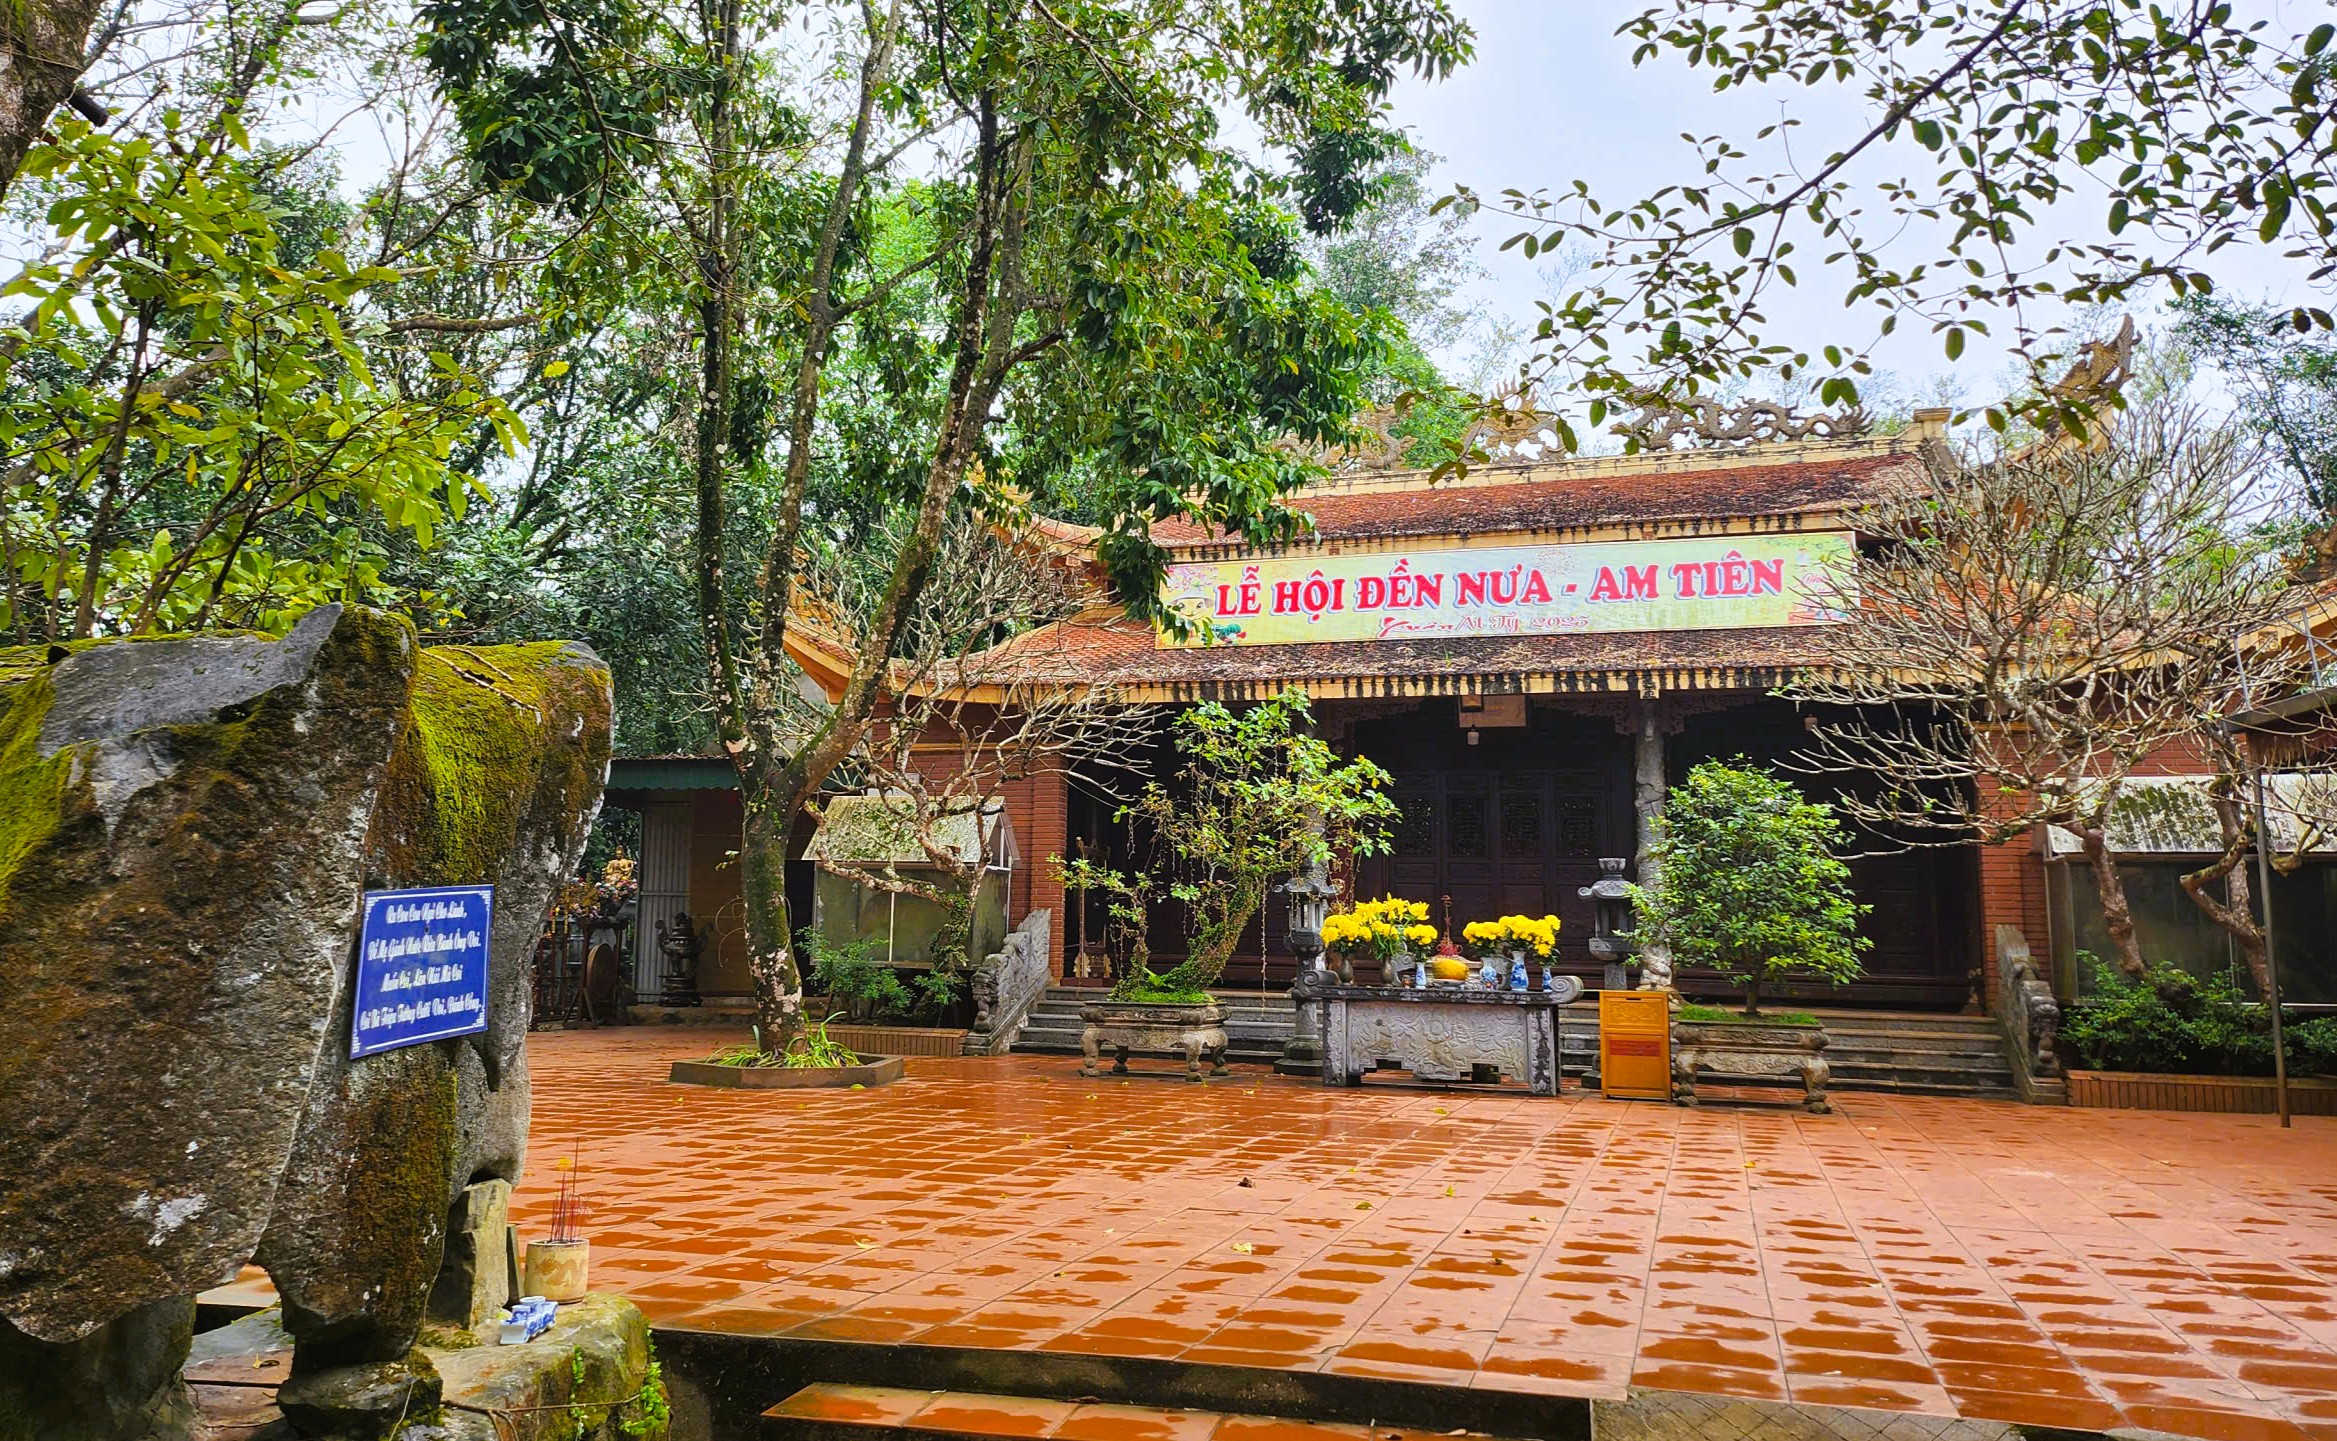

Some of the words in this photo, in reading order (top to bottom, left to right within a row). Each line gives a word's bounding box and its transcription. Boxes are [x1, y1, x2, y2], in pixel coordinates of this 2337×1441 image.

[1214, 565, 1263, 617] LỄ
[1273, 569, 1347, 622] HỘI
[1356, 557, 1445, 610] ĐỀN
[1456, 563, 1553, 606] NƯA
[1565, 583, 1578, 593] -
[1589, 565, 1660, 601] AM
[1672, 549, 1785, 598] TIÊN
[1530, 615, 1590, 629] 2025
